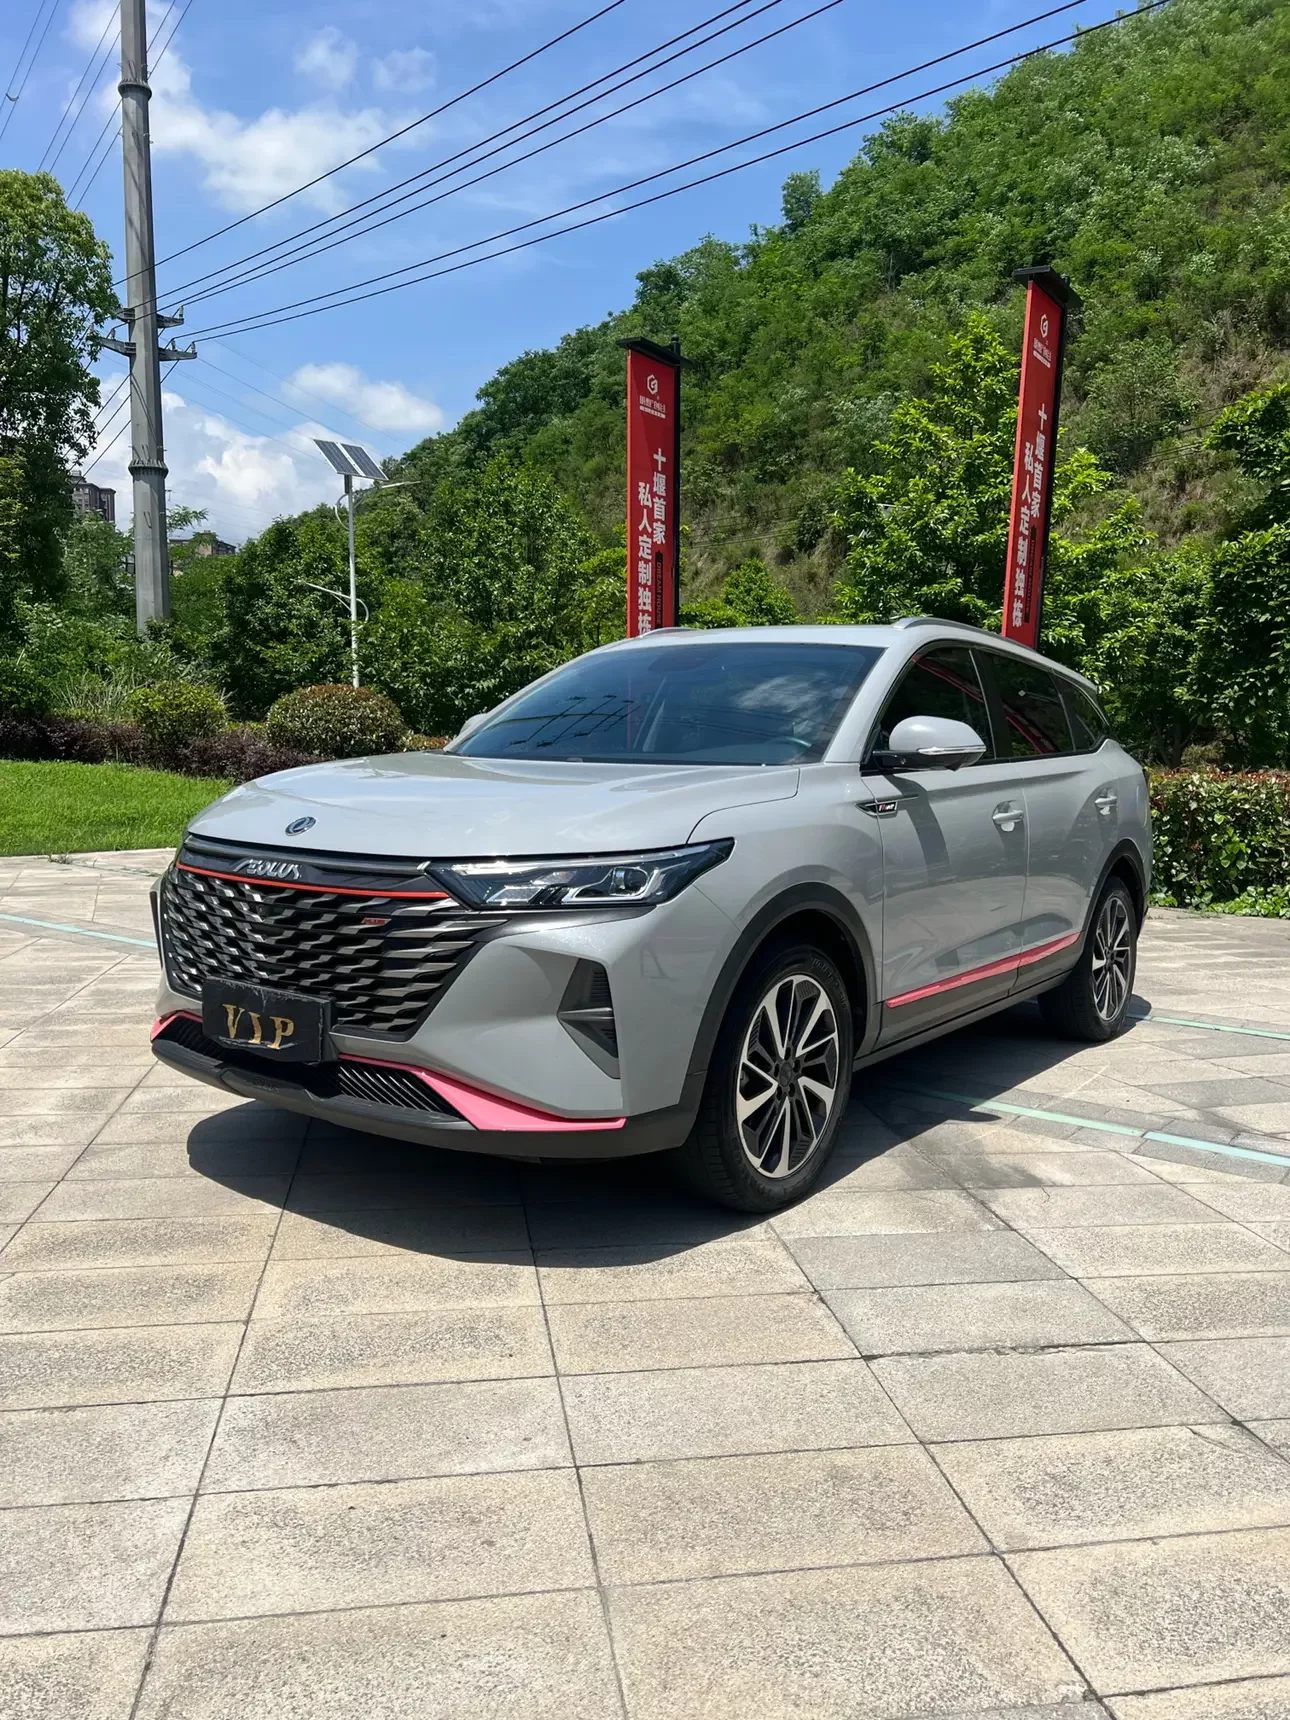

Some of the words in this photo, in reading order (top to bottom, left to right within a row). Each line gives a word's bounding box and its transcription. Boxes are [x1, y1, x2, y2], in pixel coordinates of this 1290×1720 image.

[652, 447, 667, 545] 十堰首家
[1031, 403, 1048, 518] 十堰首家
[638, 481, 653, 635] 私人定制独栋
[222, 1003, 296, 1050] VIP
